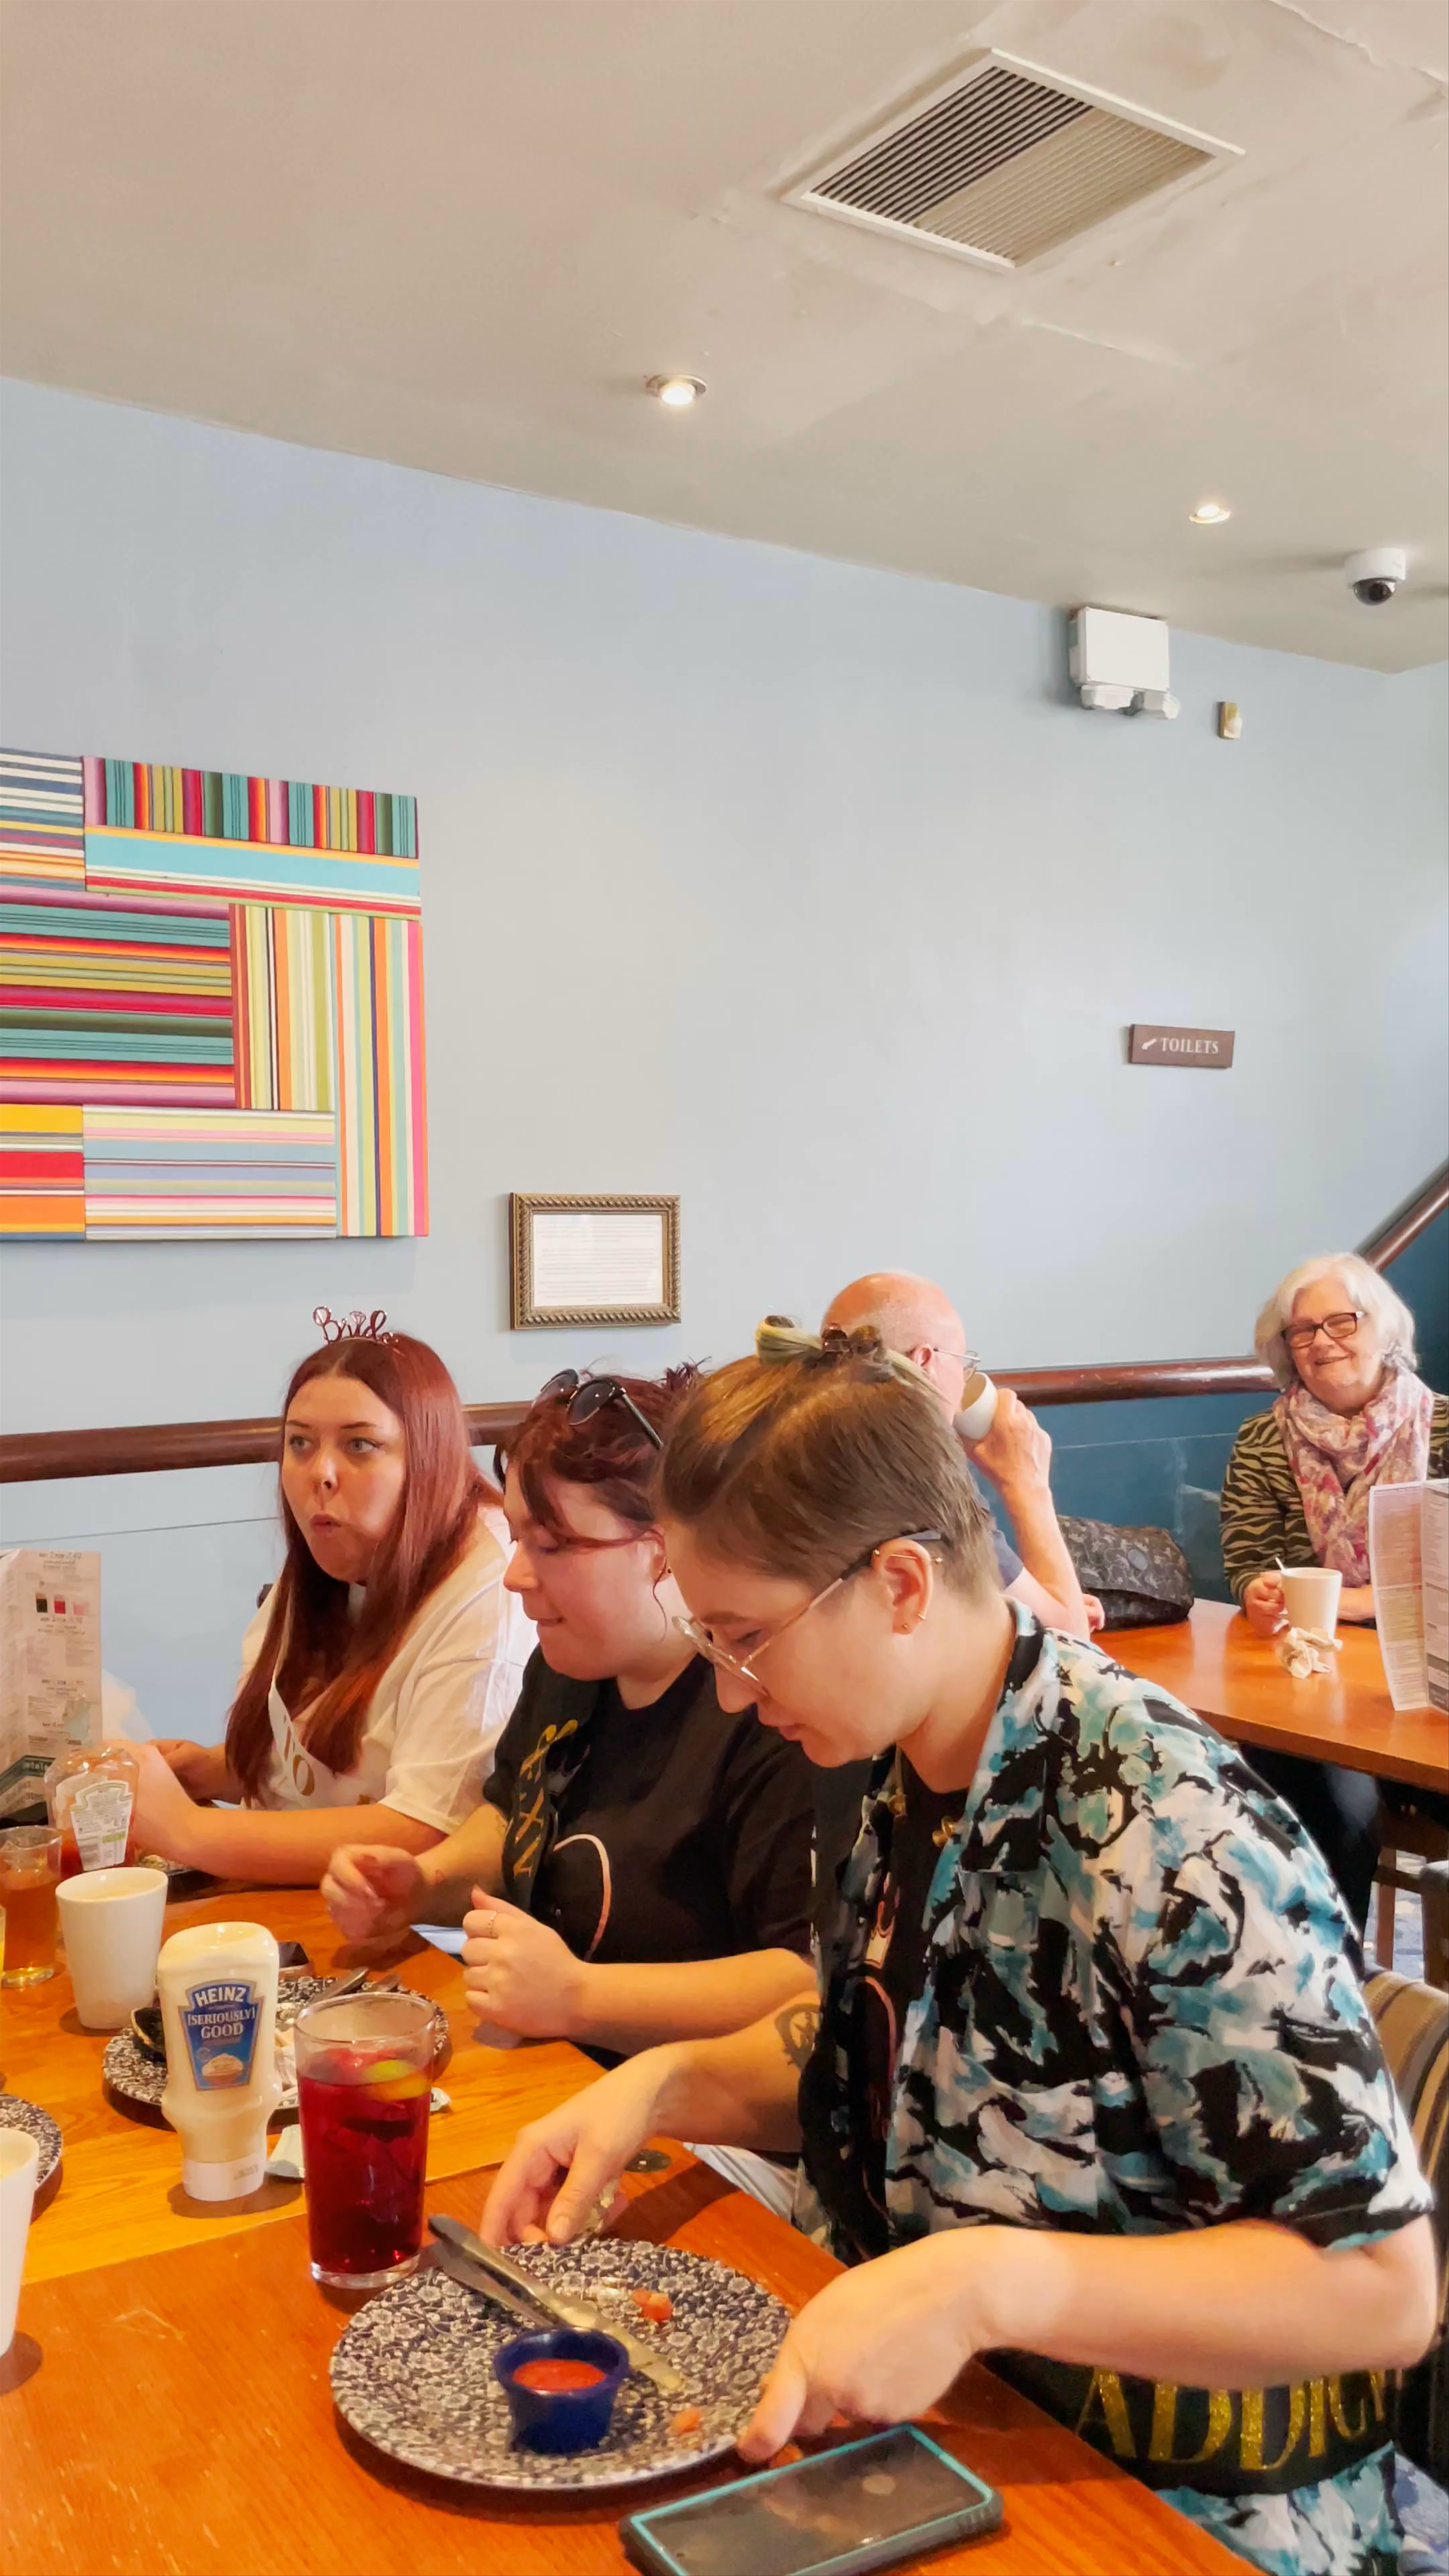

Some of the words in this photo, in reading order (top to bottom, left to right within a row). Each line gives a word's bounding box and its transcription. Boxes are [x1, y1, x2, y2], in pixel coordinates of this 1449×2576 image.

[1161, 1037, 1219, 1053] TOILETS
[195, 1987, 246, 2007] HEINZ
[201, 2023, 243, 2039] GOOD
